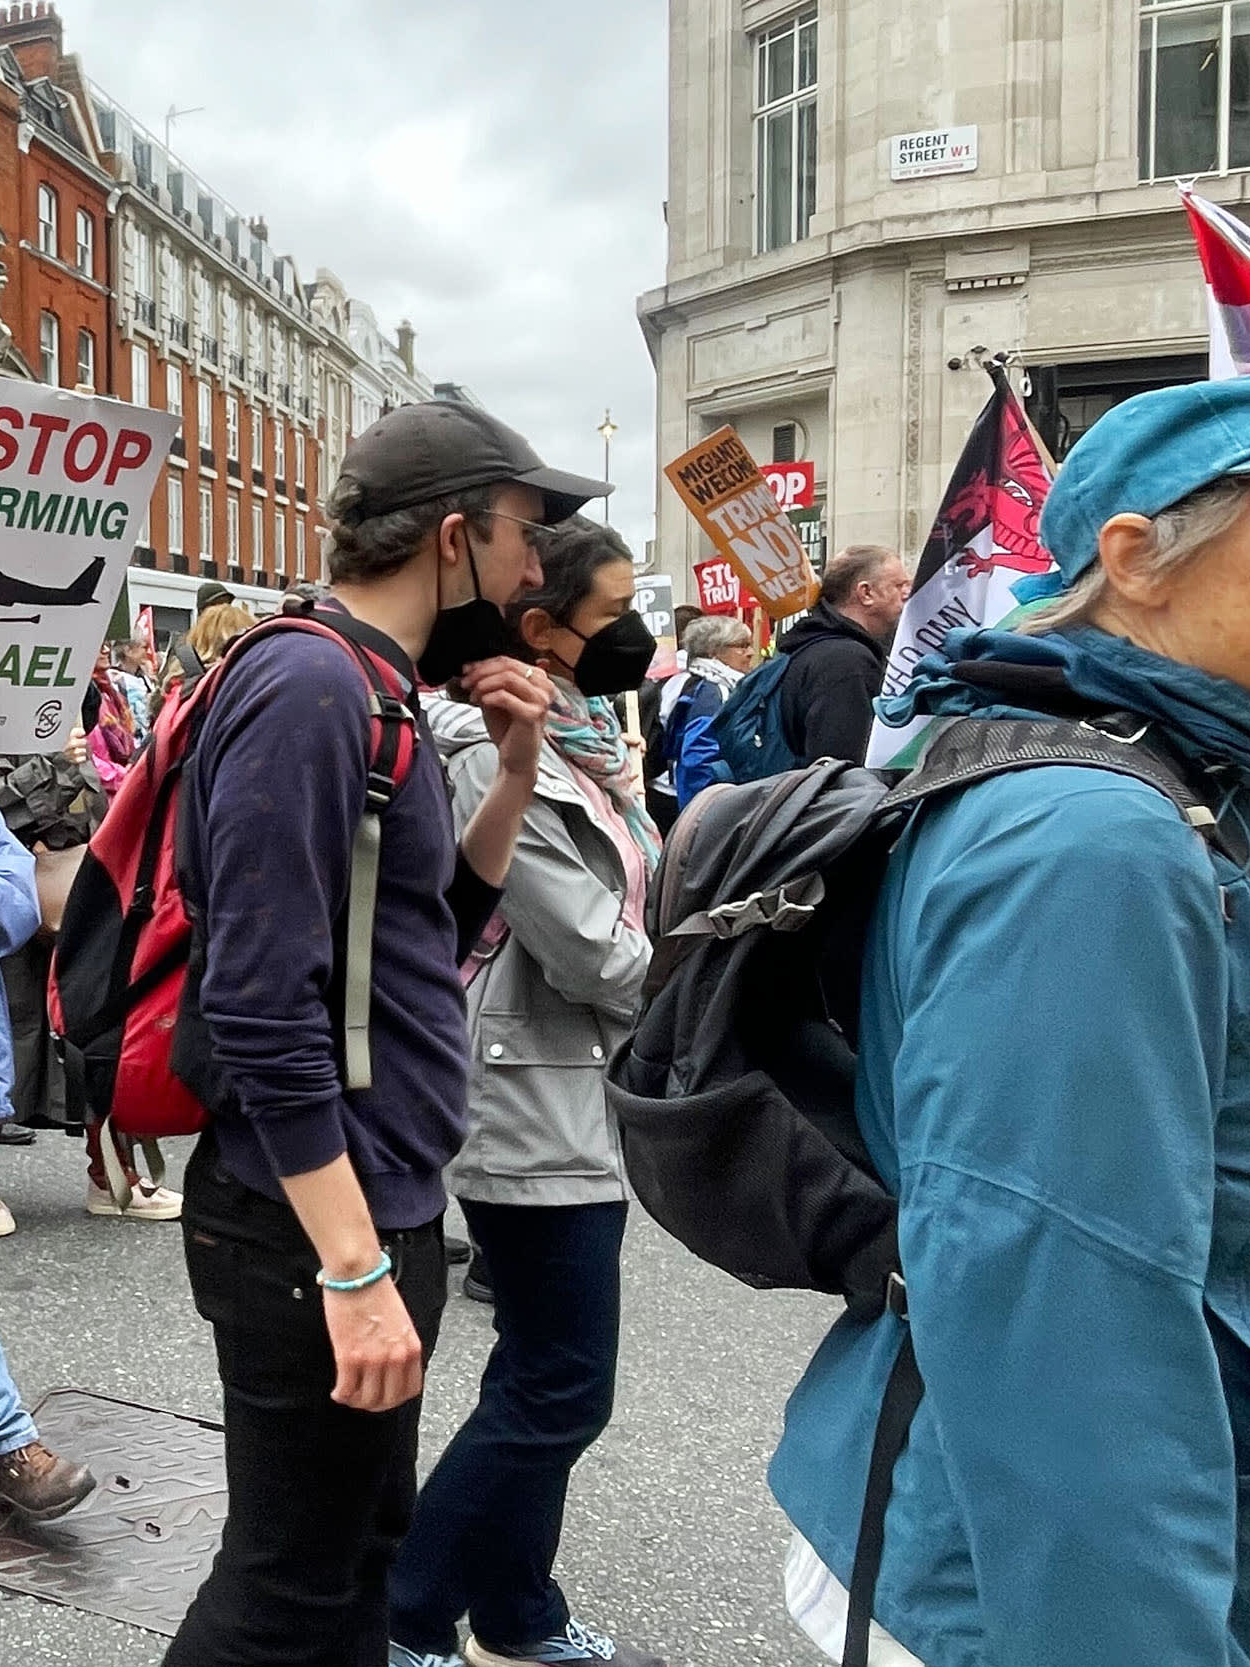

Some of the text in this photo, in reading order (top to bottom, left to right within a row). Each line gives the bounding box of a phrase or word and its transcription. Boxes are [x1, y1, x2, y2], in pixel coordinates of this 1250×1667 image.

[900, 134, 949, 150] REGENT
[899, 145, 970, 164] STREET W1
